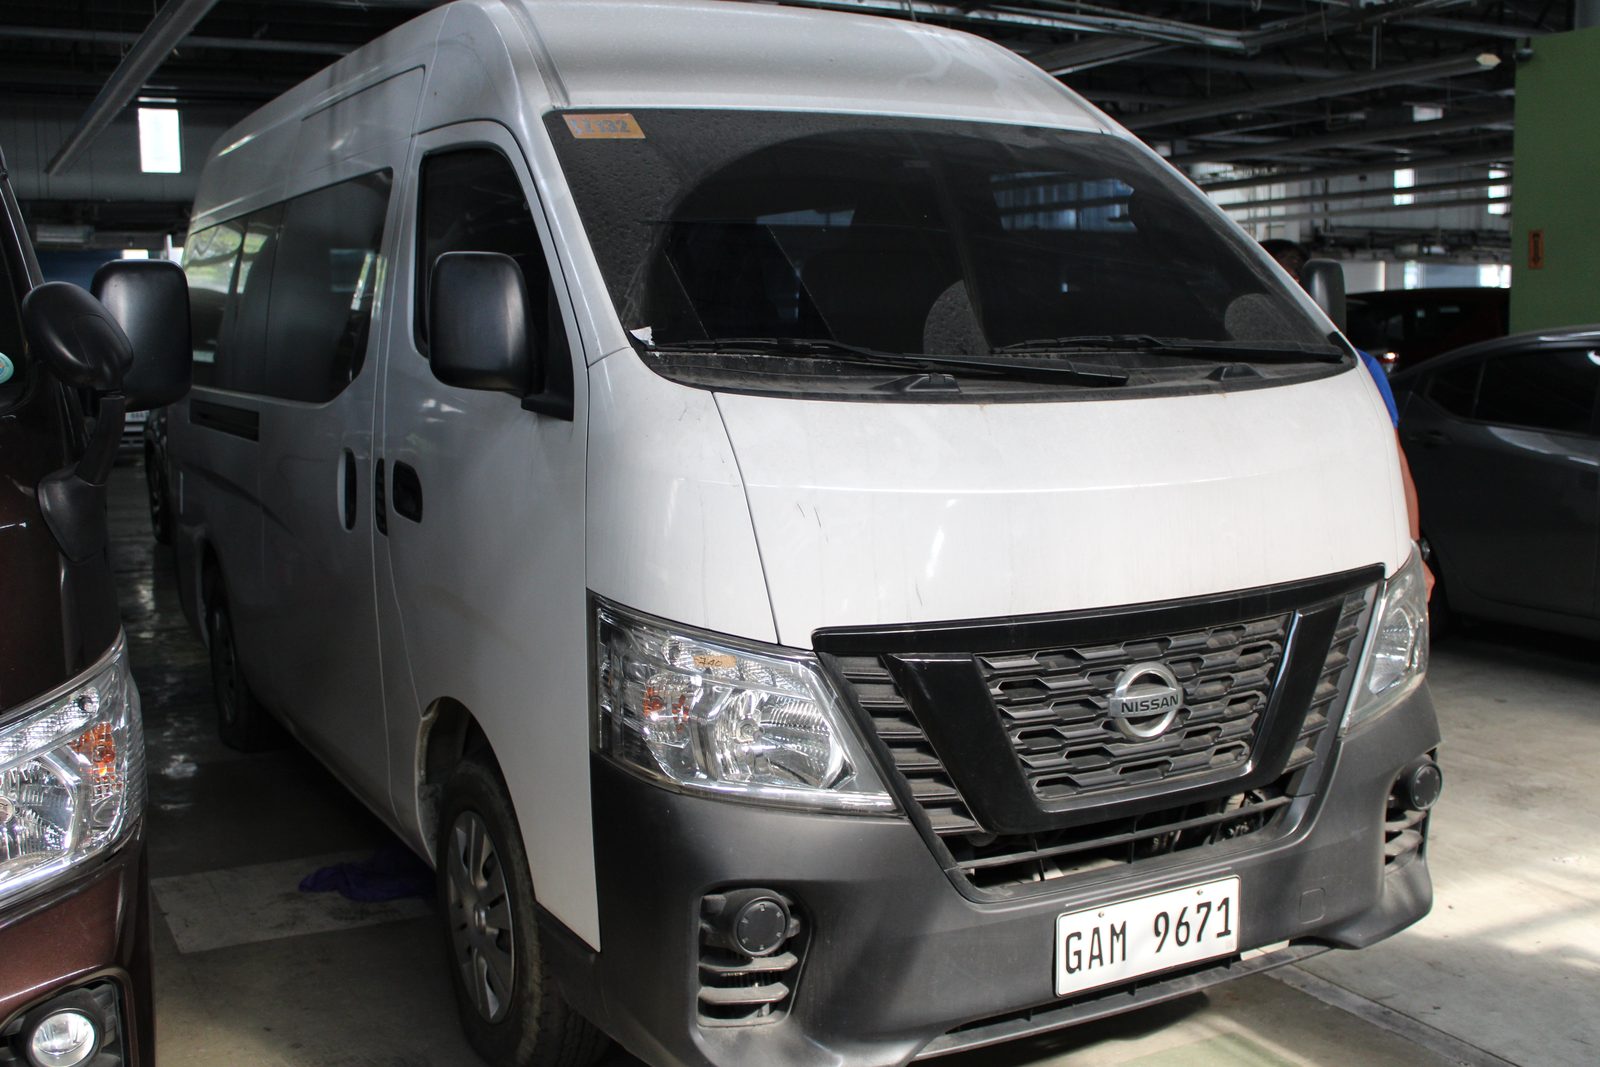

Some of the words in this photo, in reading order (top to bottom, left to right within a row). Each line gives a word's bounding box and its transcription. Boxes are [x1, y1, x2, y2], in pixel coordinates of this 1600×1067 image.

[1121, 694, 1179, 713] NISSAN
[1065, 920, 1127, 975] GAM
[1153, 896, 1232, 954] 9671
